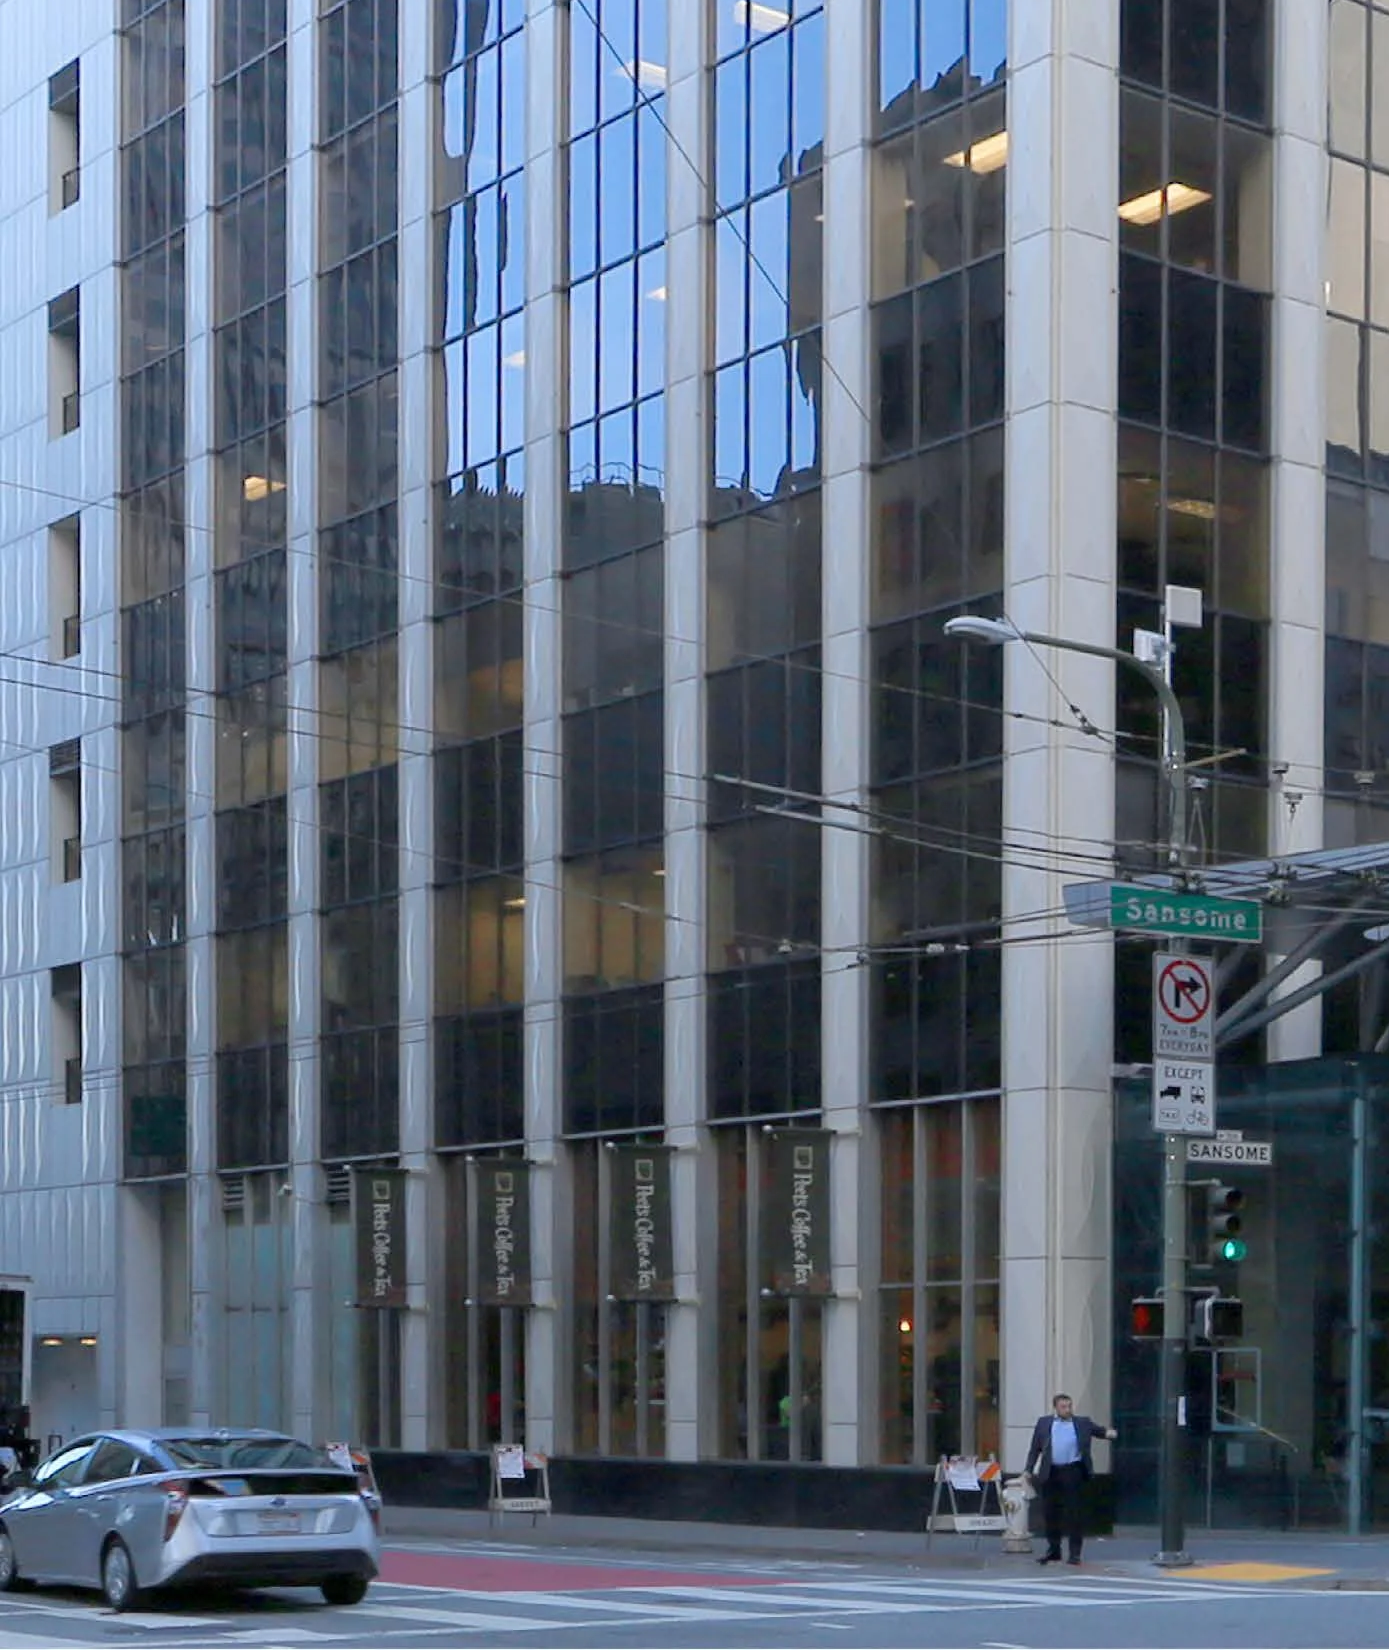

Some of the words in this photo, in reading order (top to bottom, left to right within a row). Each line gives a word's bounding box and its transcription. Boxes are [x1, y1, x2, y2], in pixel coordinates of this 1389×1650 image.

[1126, 897, 1247, 931] Sansome
[1159, 1039, 1209, 1052] EVERYDAY
[1164, 1066, 1203, 1080] EXCEPT
[1190, 1143, 1269, 1161] SANSOME
